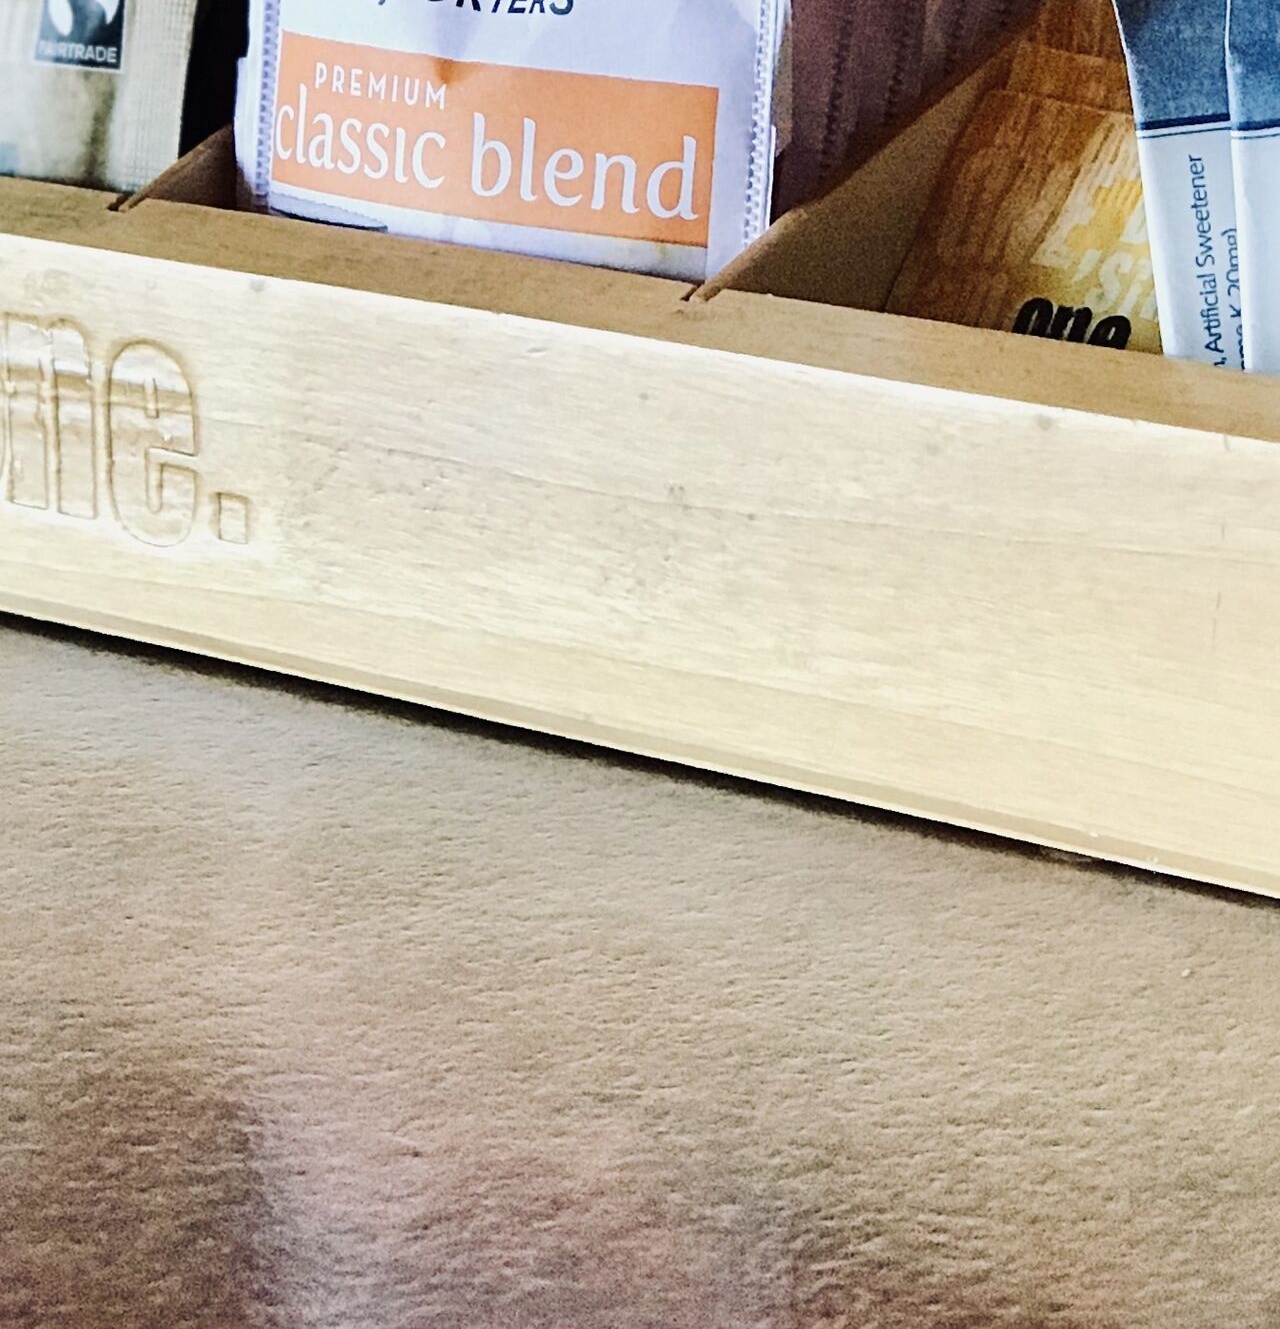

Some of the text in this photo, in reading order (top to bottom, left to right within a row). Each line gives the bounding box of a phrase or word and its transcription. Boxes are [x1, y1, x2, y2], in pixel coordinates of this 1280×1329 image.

[313, 61, 448, 111] PREMIUM
[273, 82, 701, 222] classic blend
[1188, 154, 1215, 268] Sweetener
[1196, 271, 1222, 355] Artificial
